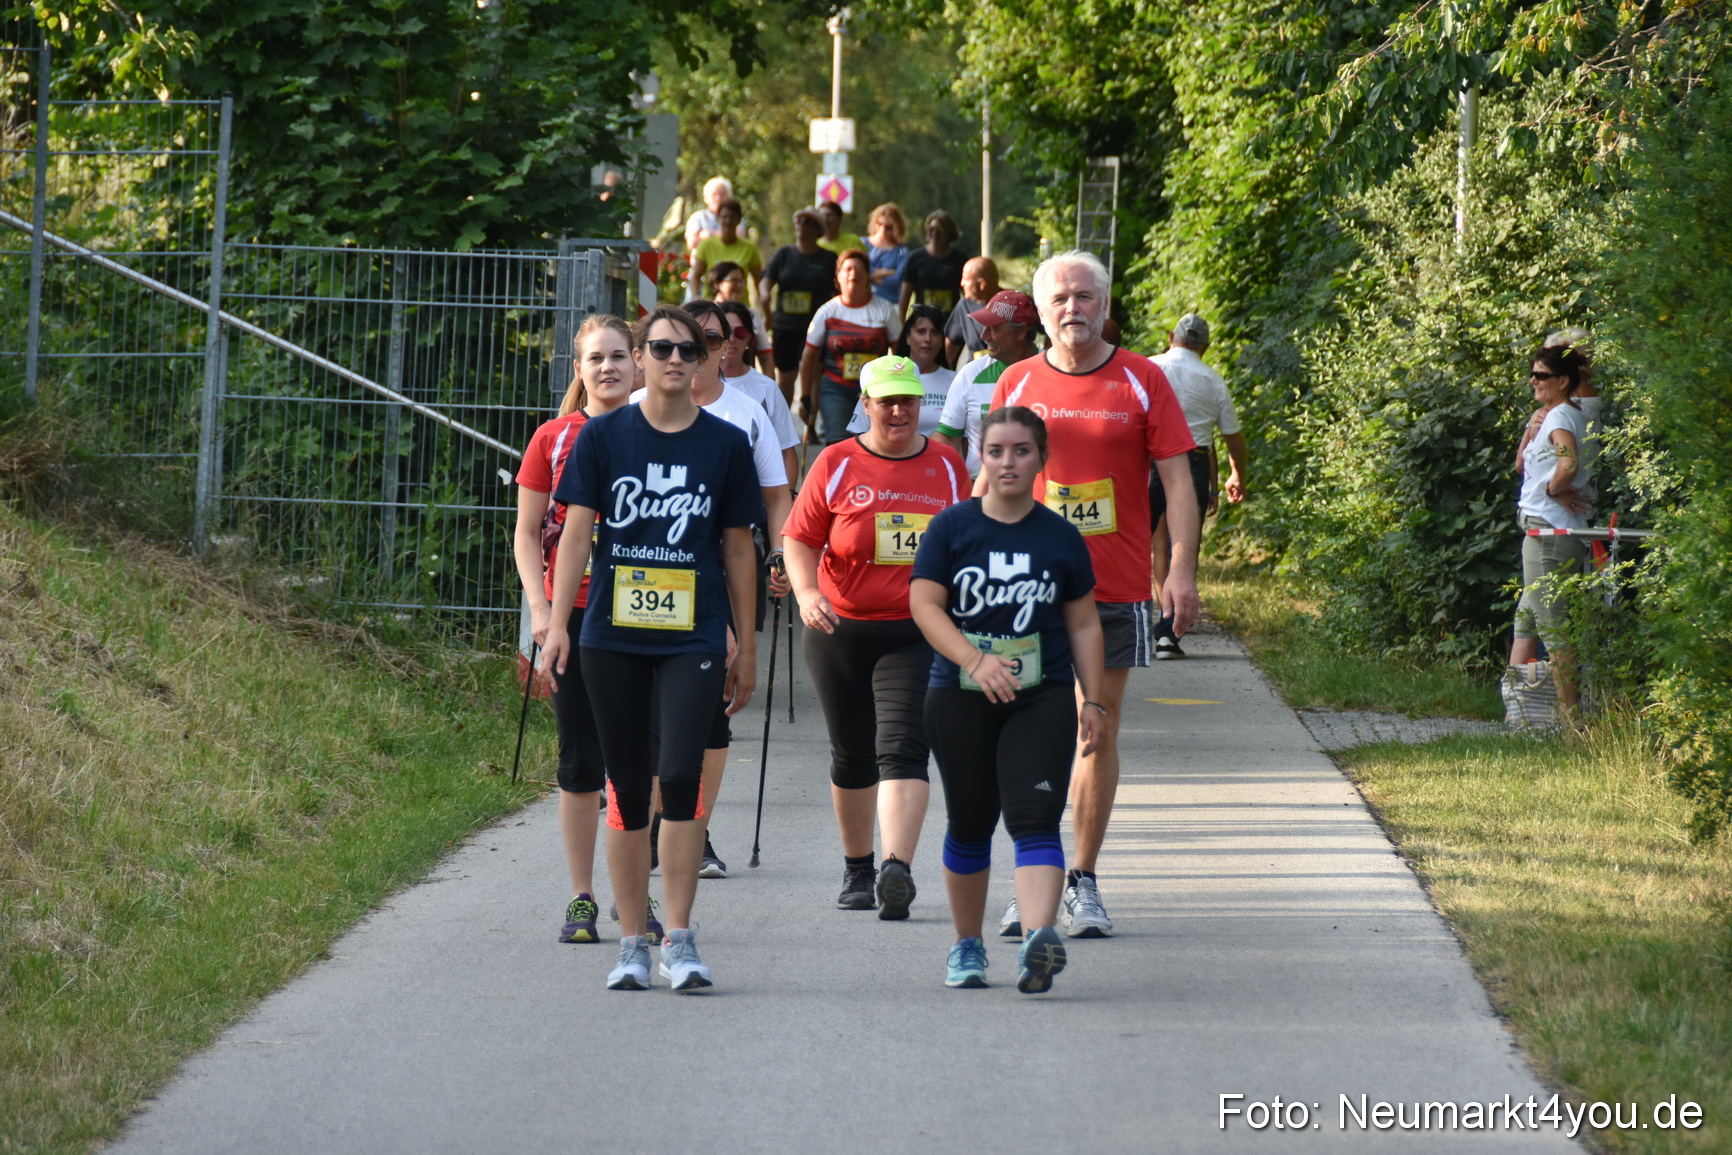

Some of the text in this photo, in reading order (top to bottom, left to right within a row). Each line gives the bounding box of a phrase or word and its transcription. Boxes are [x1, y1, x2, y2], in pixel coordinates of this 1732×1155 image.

[1051, 407, 1129, 424] bfwnürnberg
[877, 490, 947, 511] bfwnürnberg
[606, 476, 712, 545] Burgis
[1058, 501, 1100, 521] 144
[1084, 519, 1102, 527] Albert
[892, 531, 926, 550] 14
[611, 543, 696, 562] Knödelliebe.
[630, 589, 675, 612] 394
[952, 565, 1057, 633] Burgis
[628, 610, 677, 619] Paulus Cornelia
